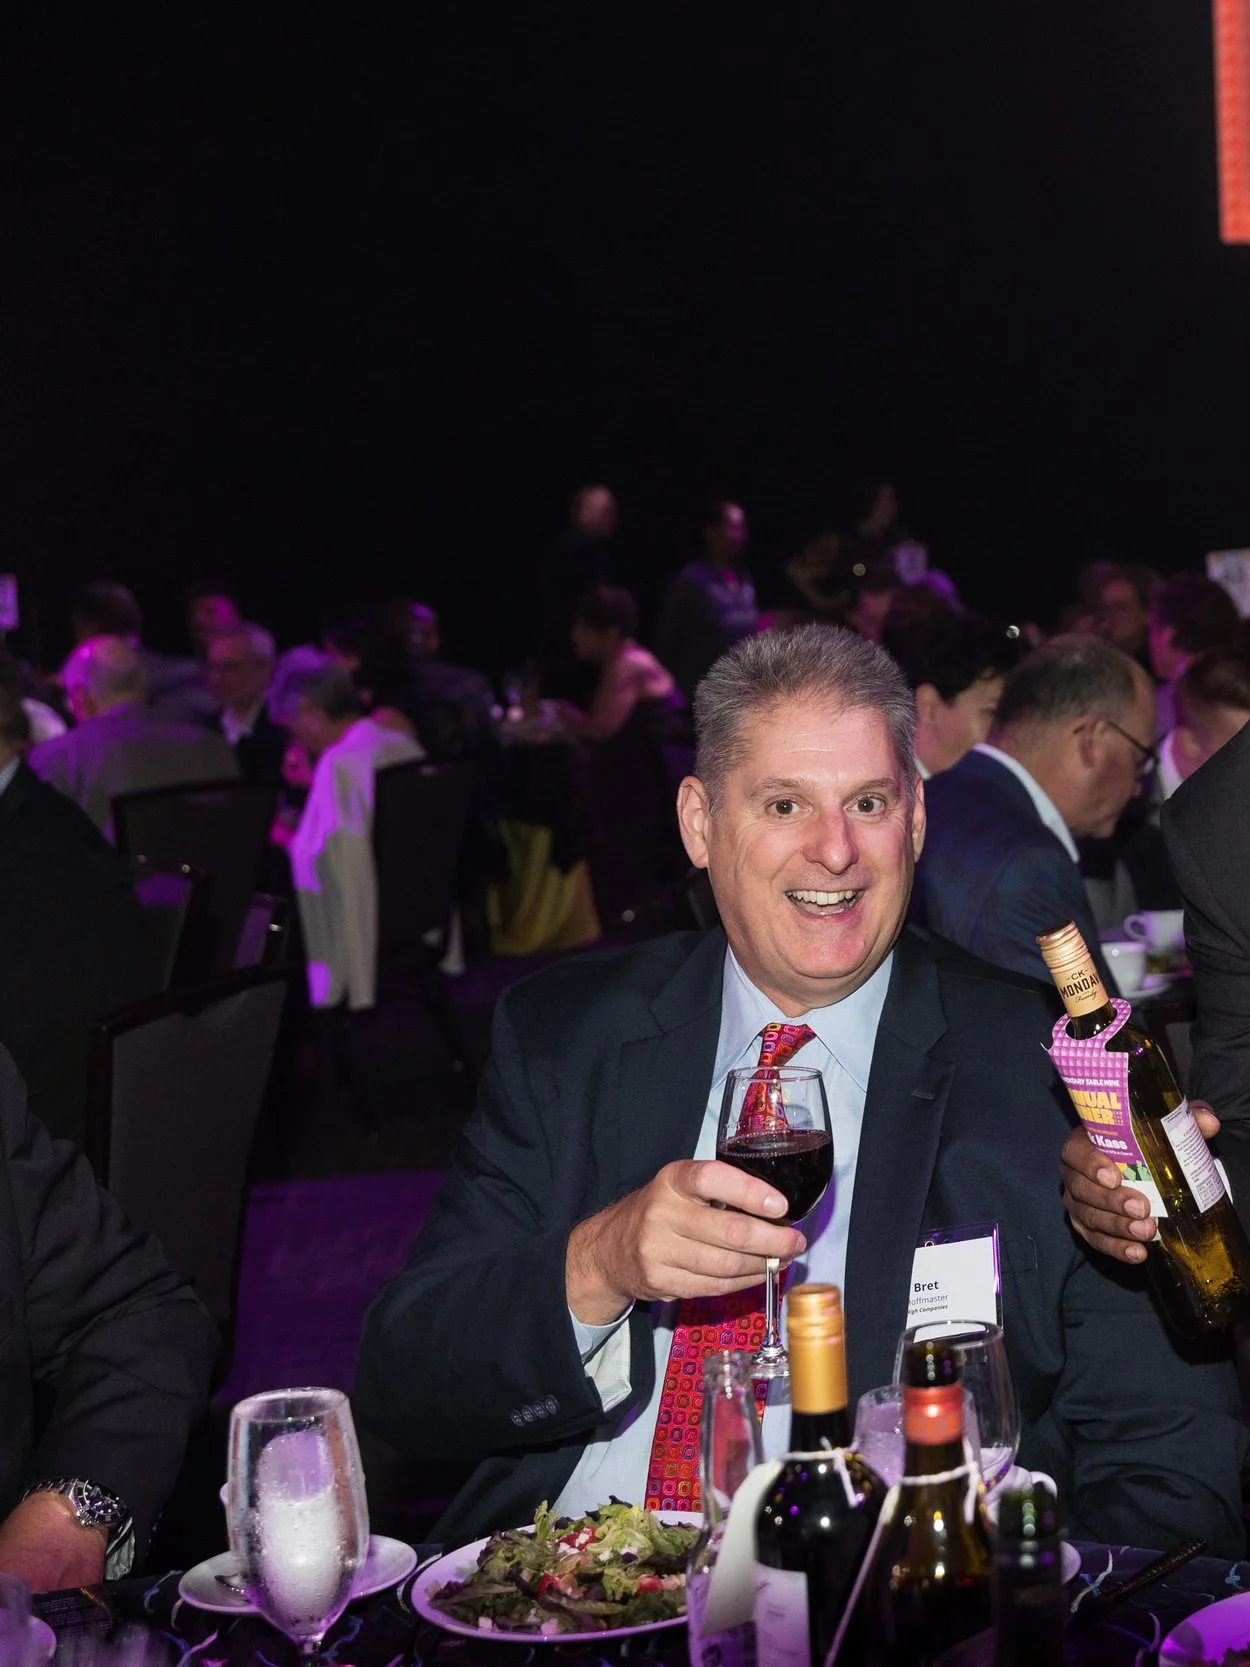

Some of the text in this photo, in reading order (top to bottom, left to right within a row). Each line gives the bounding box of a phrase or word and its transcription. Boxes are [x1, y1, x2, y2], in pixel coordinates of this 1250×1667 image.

[1071, 969, 1085, 980] CK
[1086, 1077, 1104, 1087] TABLE
[1103, 1079, 1120, 1087] WINE
[1095, 1134, 1128, 1150] Kass
[914, 1281, 939, 1292] Bret
[909, 1295, 949, 1306] offmaster
